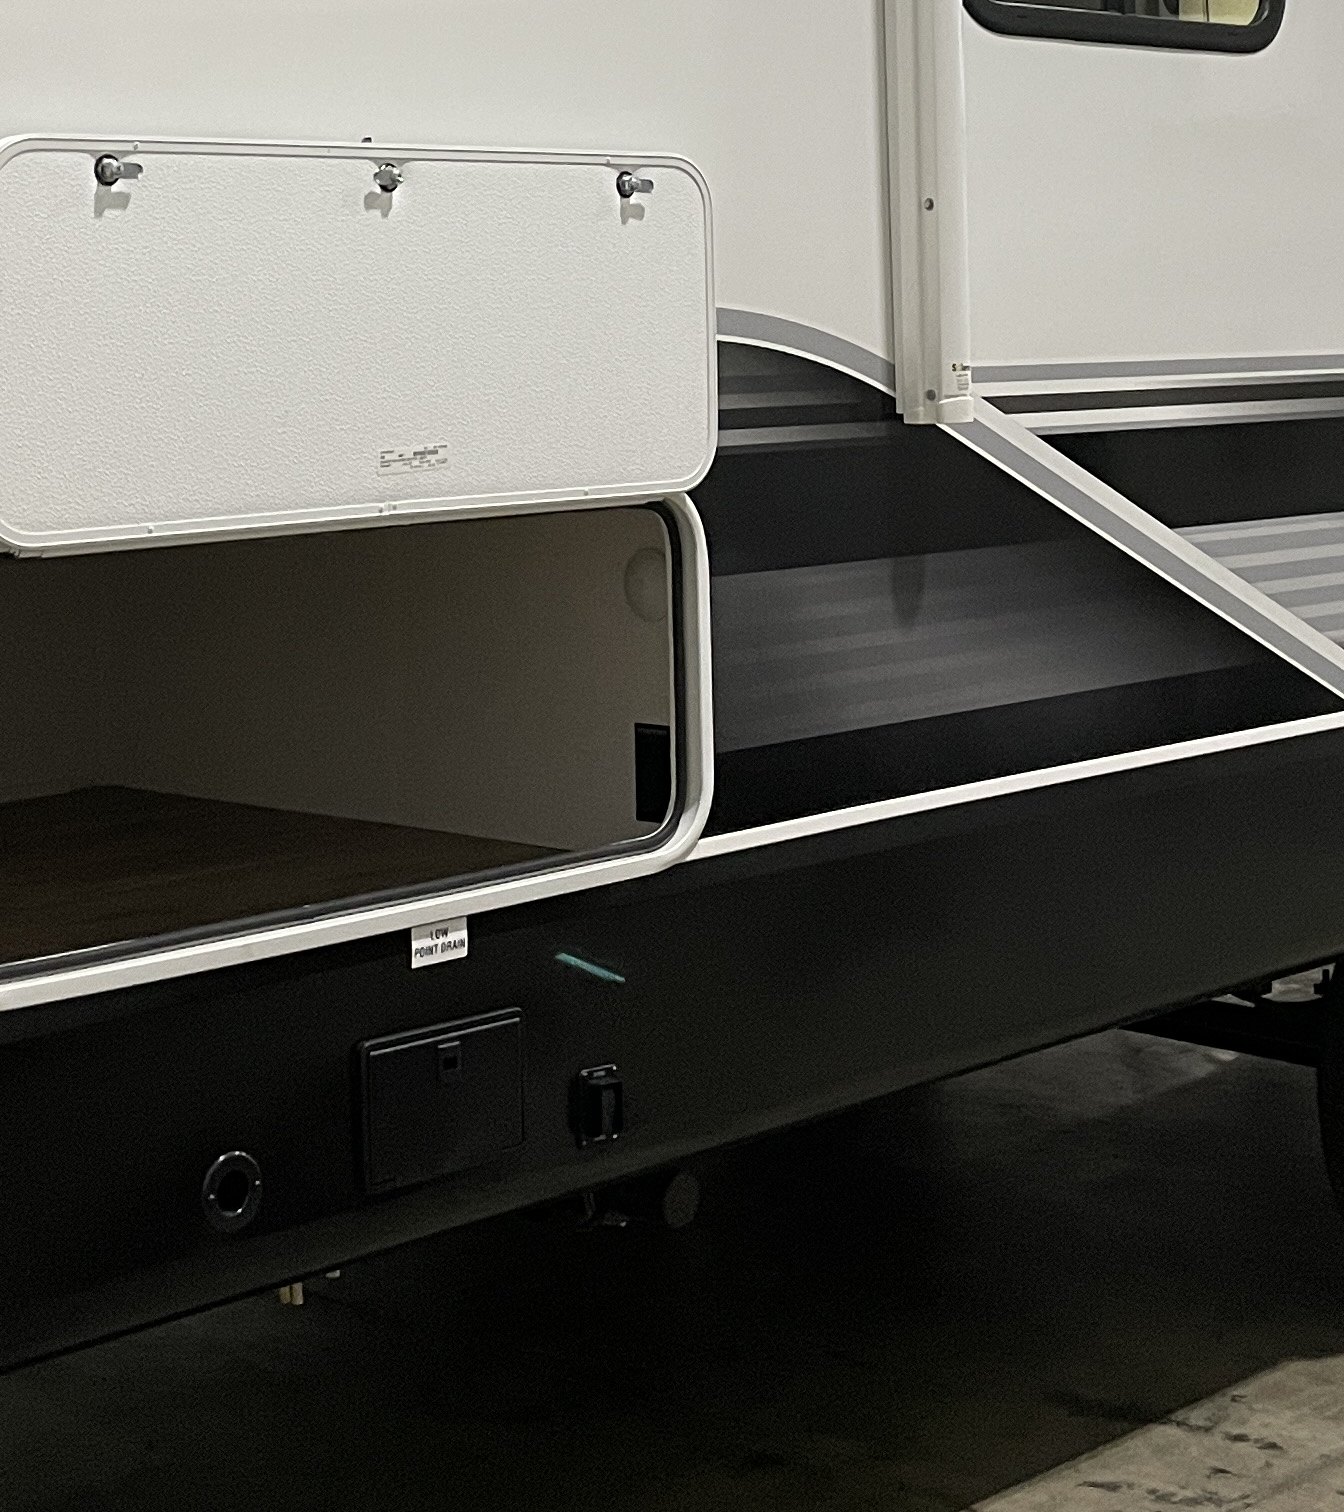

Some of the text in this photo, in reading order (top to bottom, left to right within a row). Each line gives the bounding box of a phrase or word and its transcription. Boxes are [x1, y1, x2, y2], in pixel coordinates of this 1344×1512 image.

[430, 926, 449, 940] LOW
[414, 937, 466, 958] POINT DRAIN
